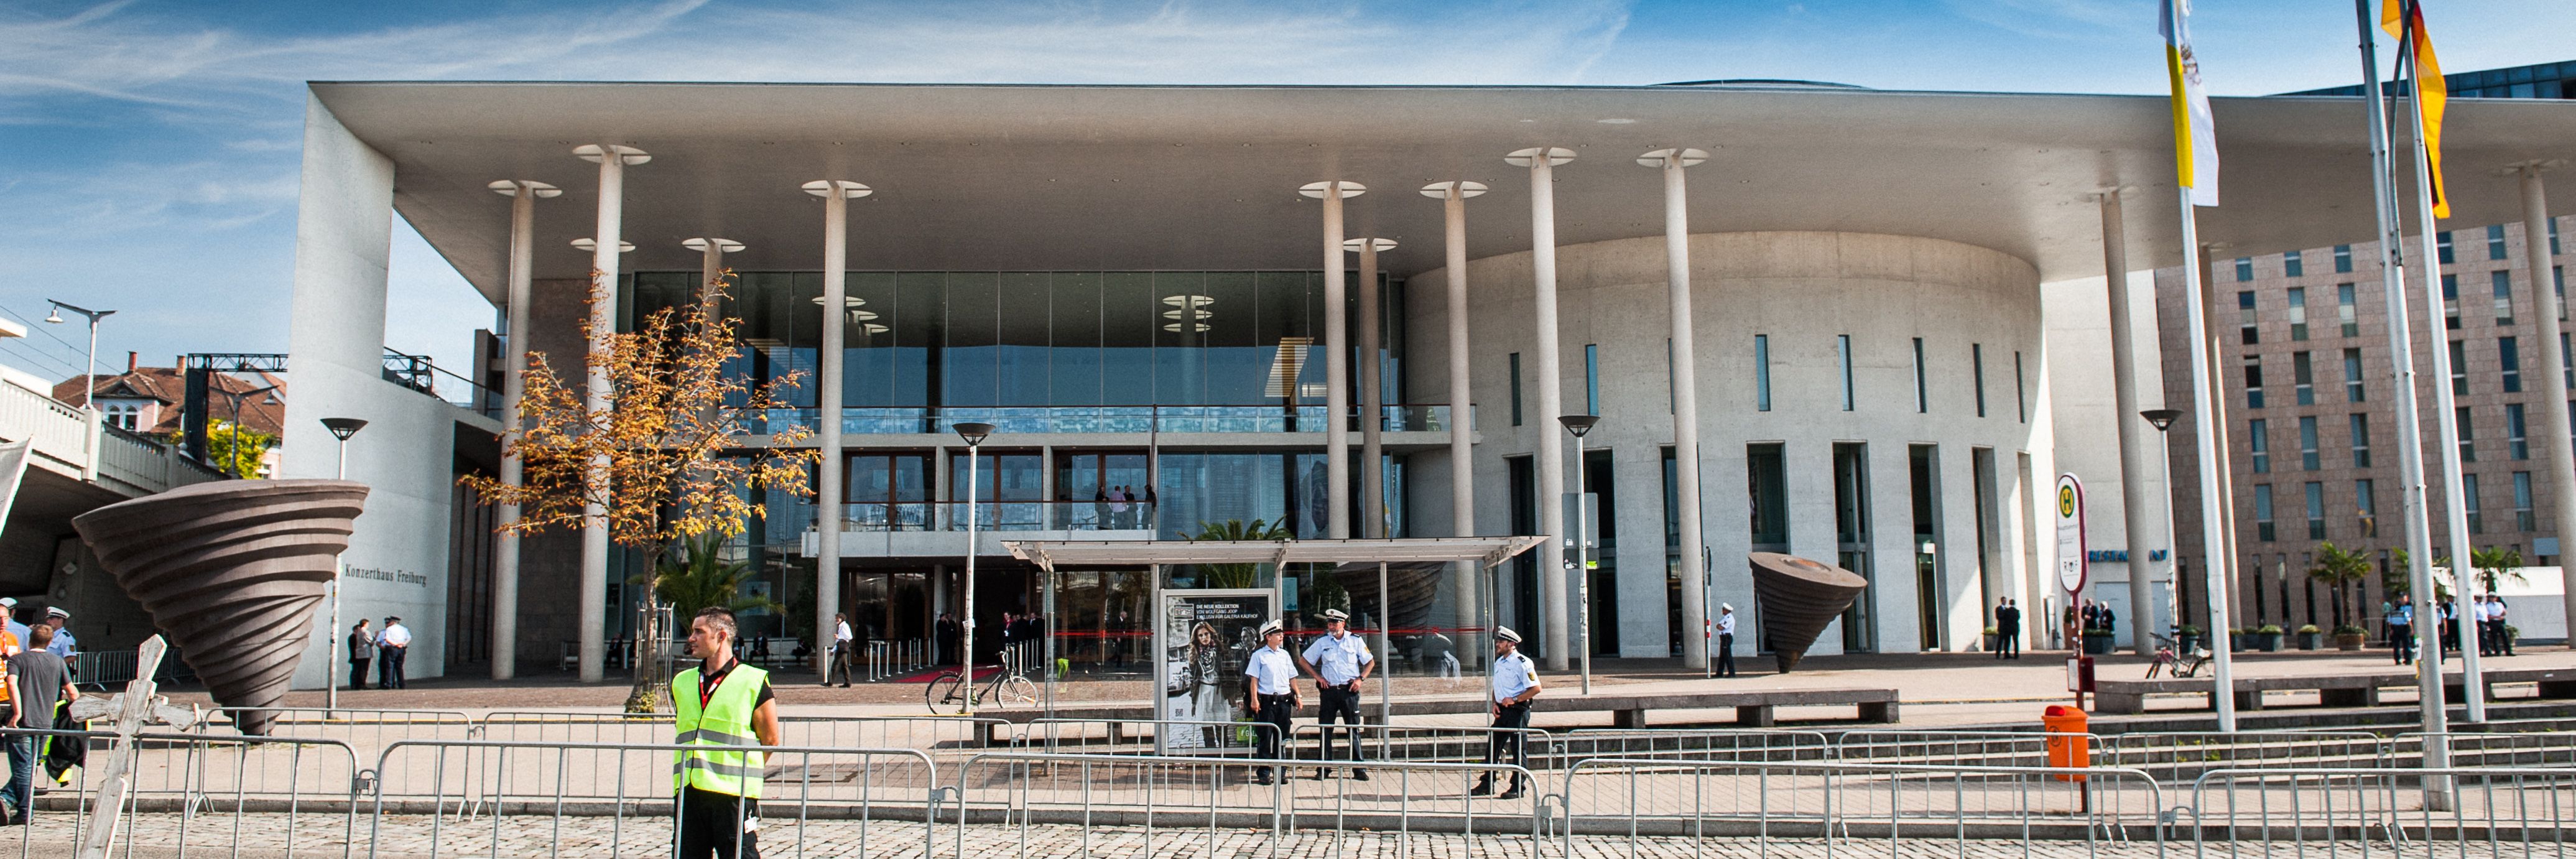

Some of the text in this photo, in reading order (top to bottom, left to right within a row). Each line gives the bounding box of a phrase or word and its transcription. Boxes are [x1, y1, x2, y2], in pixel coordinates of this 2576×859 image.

[2063, 492, 2072, 511] H
[345, 564, 427, 588] Konzerthaus Freiburg
